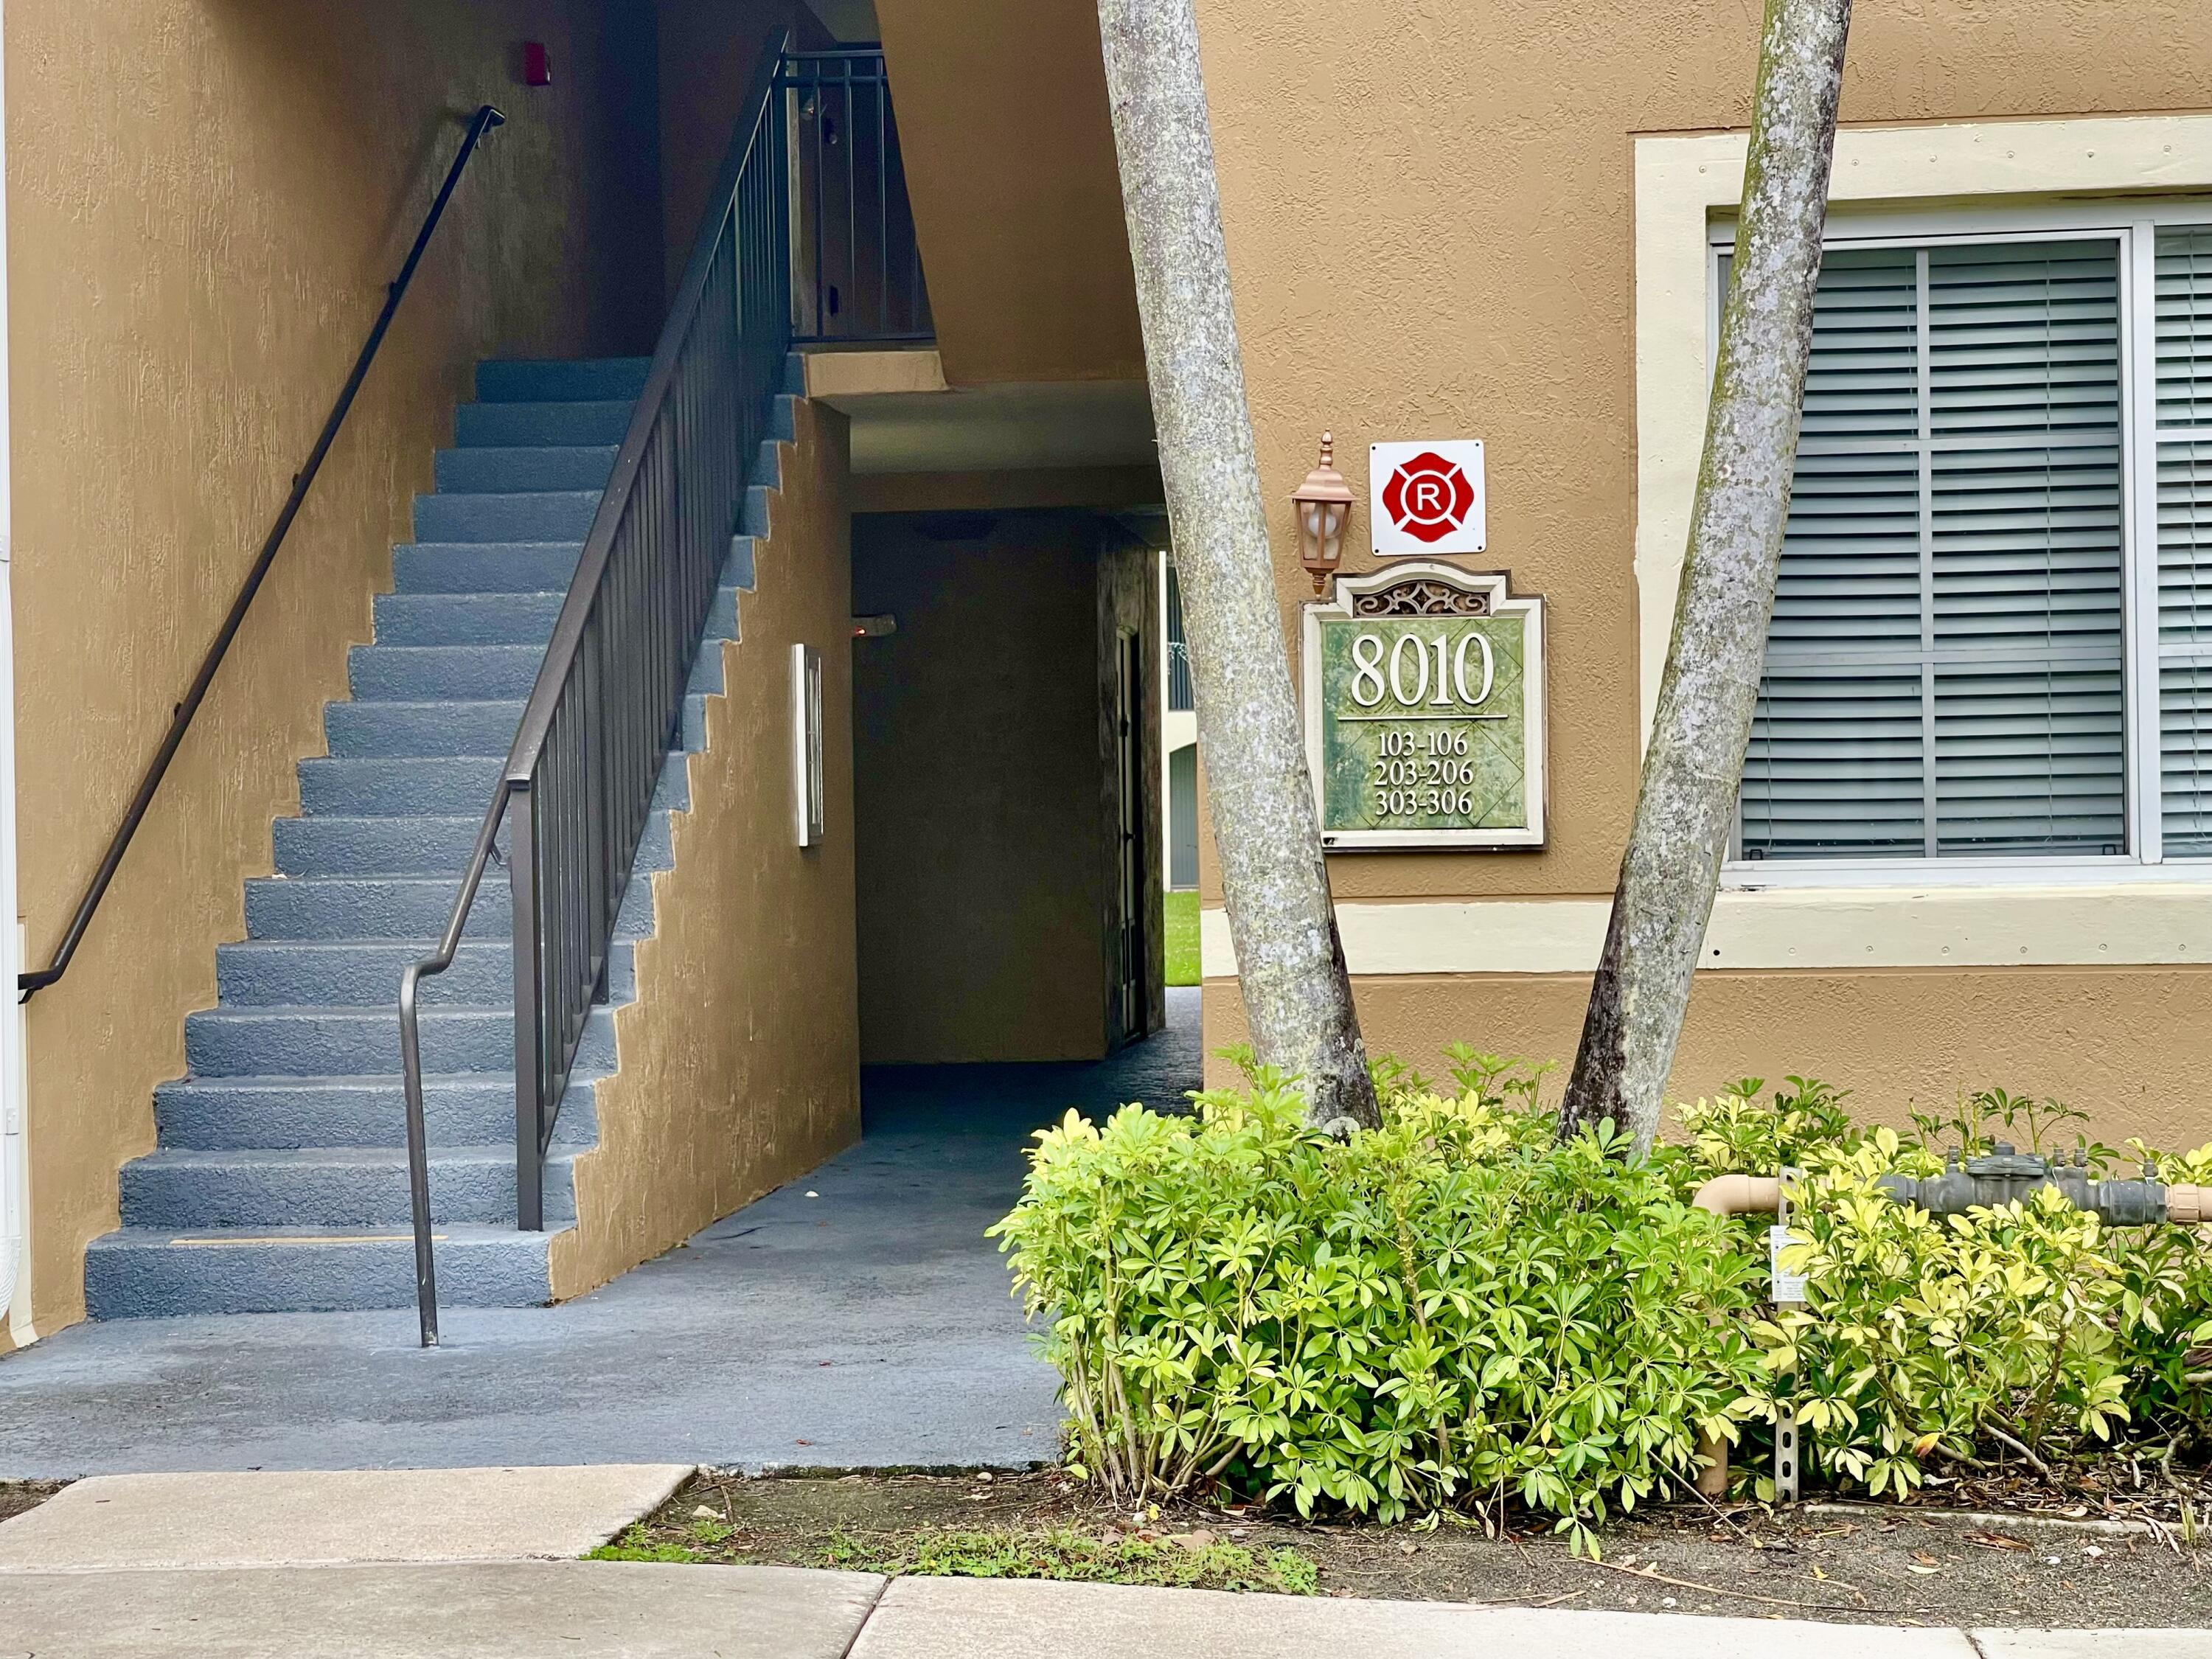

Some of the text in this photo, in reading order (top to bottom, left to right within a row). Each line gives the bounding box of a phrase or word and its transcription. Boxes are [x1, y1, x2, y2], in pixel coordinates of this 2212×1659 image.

[1416, 483, 1441, 511] R
[1351, 633, 1495, 706] 8010
[1379, 731, 1468, 758] 103-106
[1374, 759, 1474, 786] 203-206
[1375, 789, 1473, 815] 303-306
